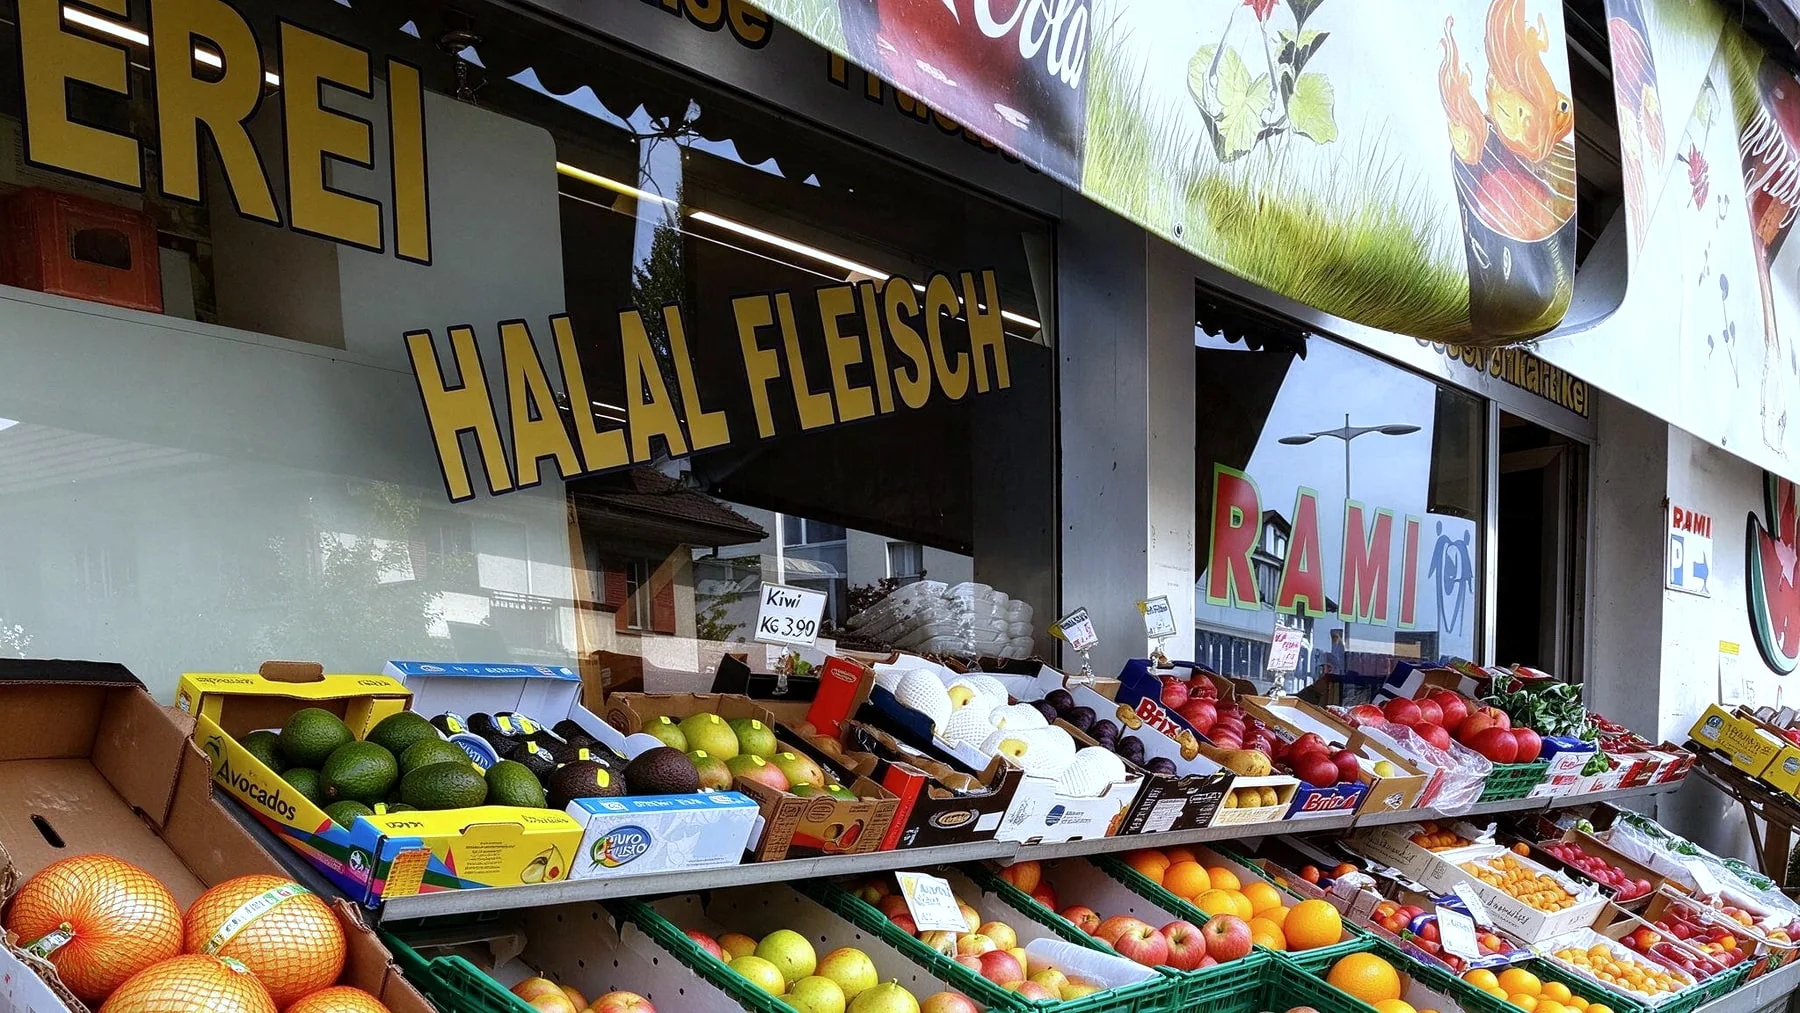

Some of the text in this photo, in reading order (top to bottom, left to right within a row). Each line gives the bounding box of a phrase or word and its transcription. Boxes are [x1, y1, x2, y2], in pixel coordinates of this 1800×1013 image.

[14, 0, 432, 266] EREI
[403, 268, 1012, 503] HALAL FLEISCH
[1206, 462, 1422, 630] RAMI
[1672, 506, 1712, 539] RAMI
[766, 587, 802, 609] Kiwi
[216, 759, 297, 821] Avocados
